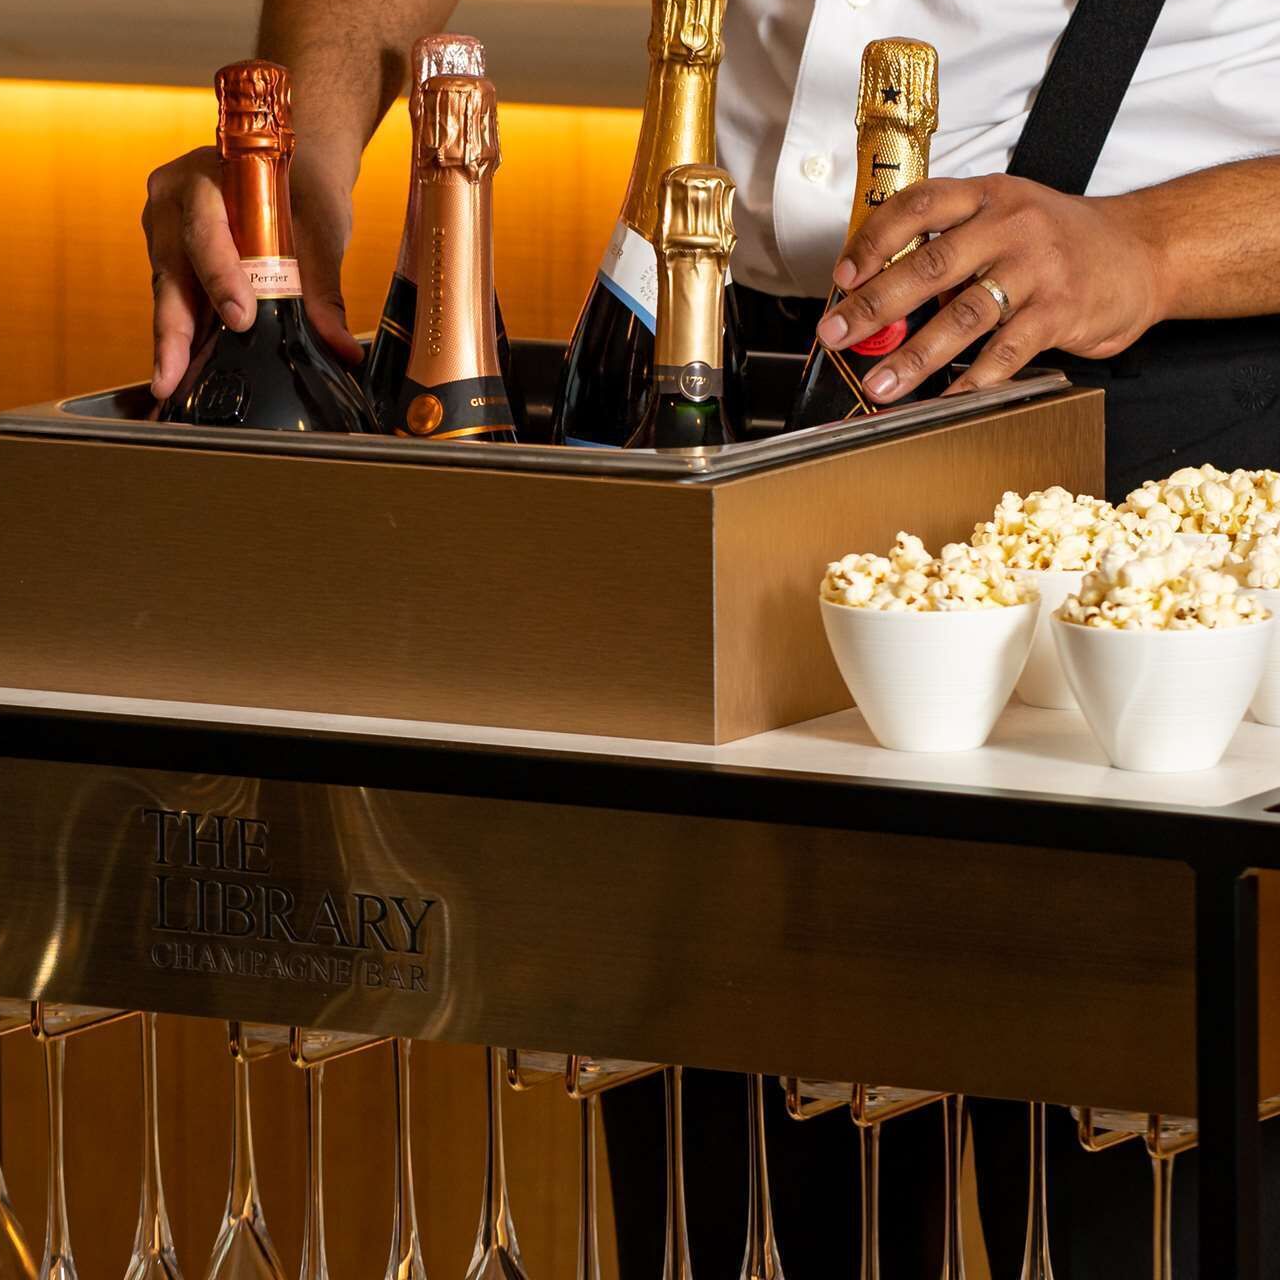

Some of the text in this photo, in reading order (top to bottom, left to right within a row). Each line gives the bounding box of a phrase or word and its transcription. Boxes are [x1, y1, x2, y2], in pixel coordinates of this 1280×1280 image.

[865, 154, 900, 208] ËT
[250, 272, 288, 283] Perrier
[143, 808, 270, 875] THE
[151, 874, 436, 955] LIBRARY
[151, 942, 429, 993] CHAMPAGNE BAR
